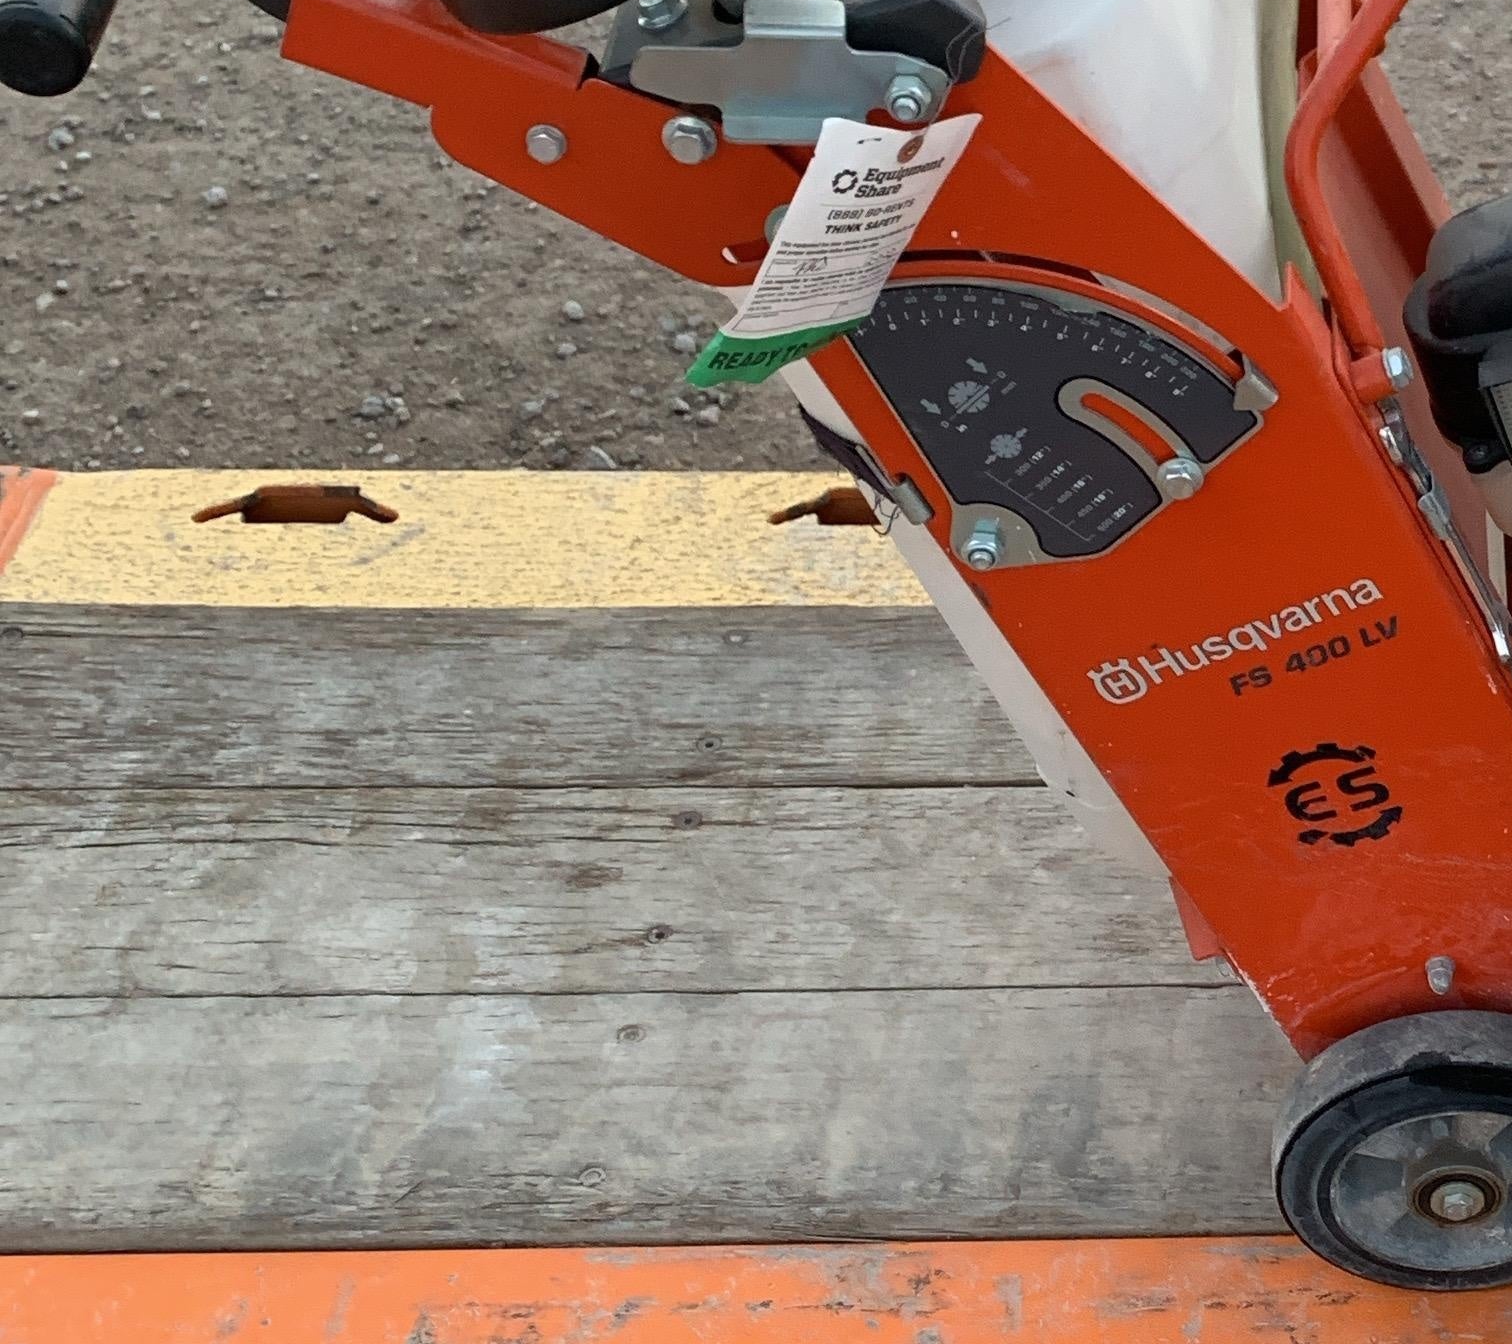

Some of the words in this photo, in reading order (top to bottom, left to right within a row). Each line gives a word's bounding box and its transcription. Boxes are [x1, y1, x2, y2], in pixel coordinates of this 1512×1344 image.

[862, 156, 945, 185] Equipment
[854, 183, 902, 198] Share
[824, 222, 862, 234] THINK
[864, 214, 903, 231] SAFETY
[707, 347, 783, 370] READY
[1137, 578, 1384, 685] Husqvarna
[1229, 666, 1273, 697] FS
[1286, 636, 1351, 673] 400
[1359, 615, 1398, 648] LV
[1283, 765, 1390, 823] ES
